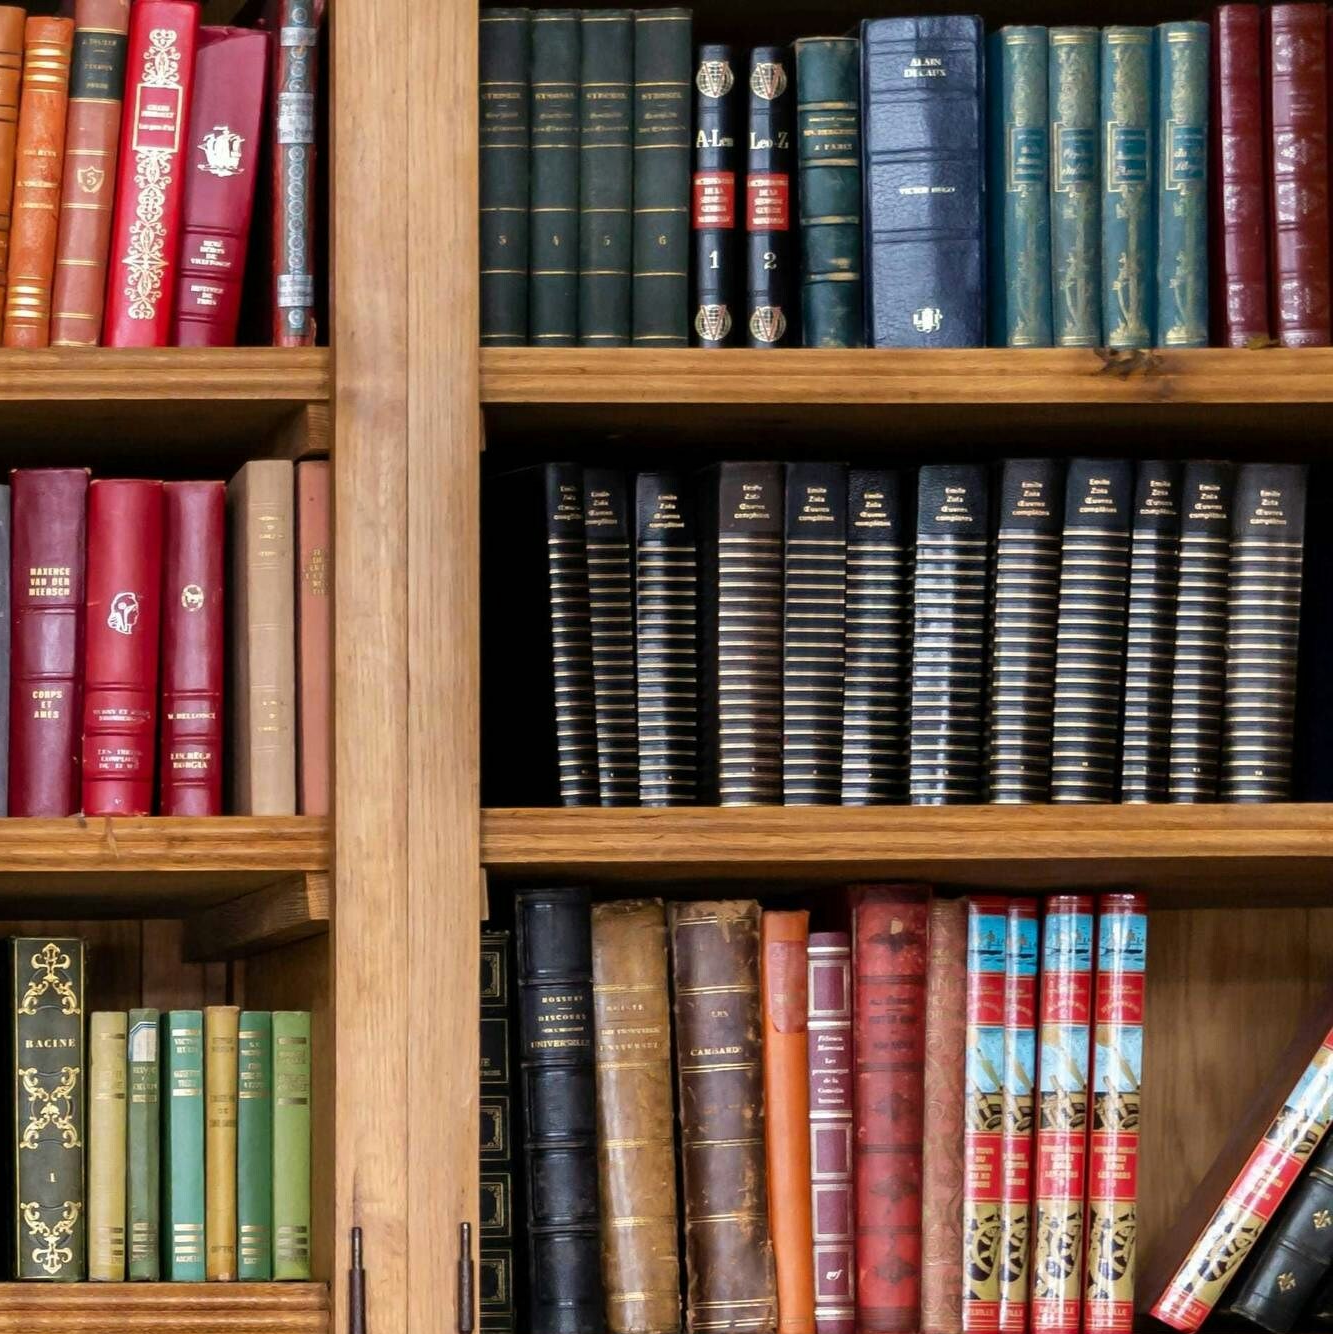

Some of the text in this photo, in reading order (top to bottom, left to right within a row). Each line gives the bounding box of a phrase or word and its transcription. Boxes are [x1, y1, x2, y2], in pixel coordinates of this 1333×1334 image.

[910, 58, 941, 67] ALAIN
[709, 251, 719, 269] 1
[764, 252, 777, 270] 2
[30, 568, 71, 576] MAXENCE
[30, 578, 70, 586] VAN DER
[32, 691, 63, 699] CORPS
[25, 1039, 76, 1049] RACINE
